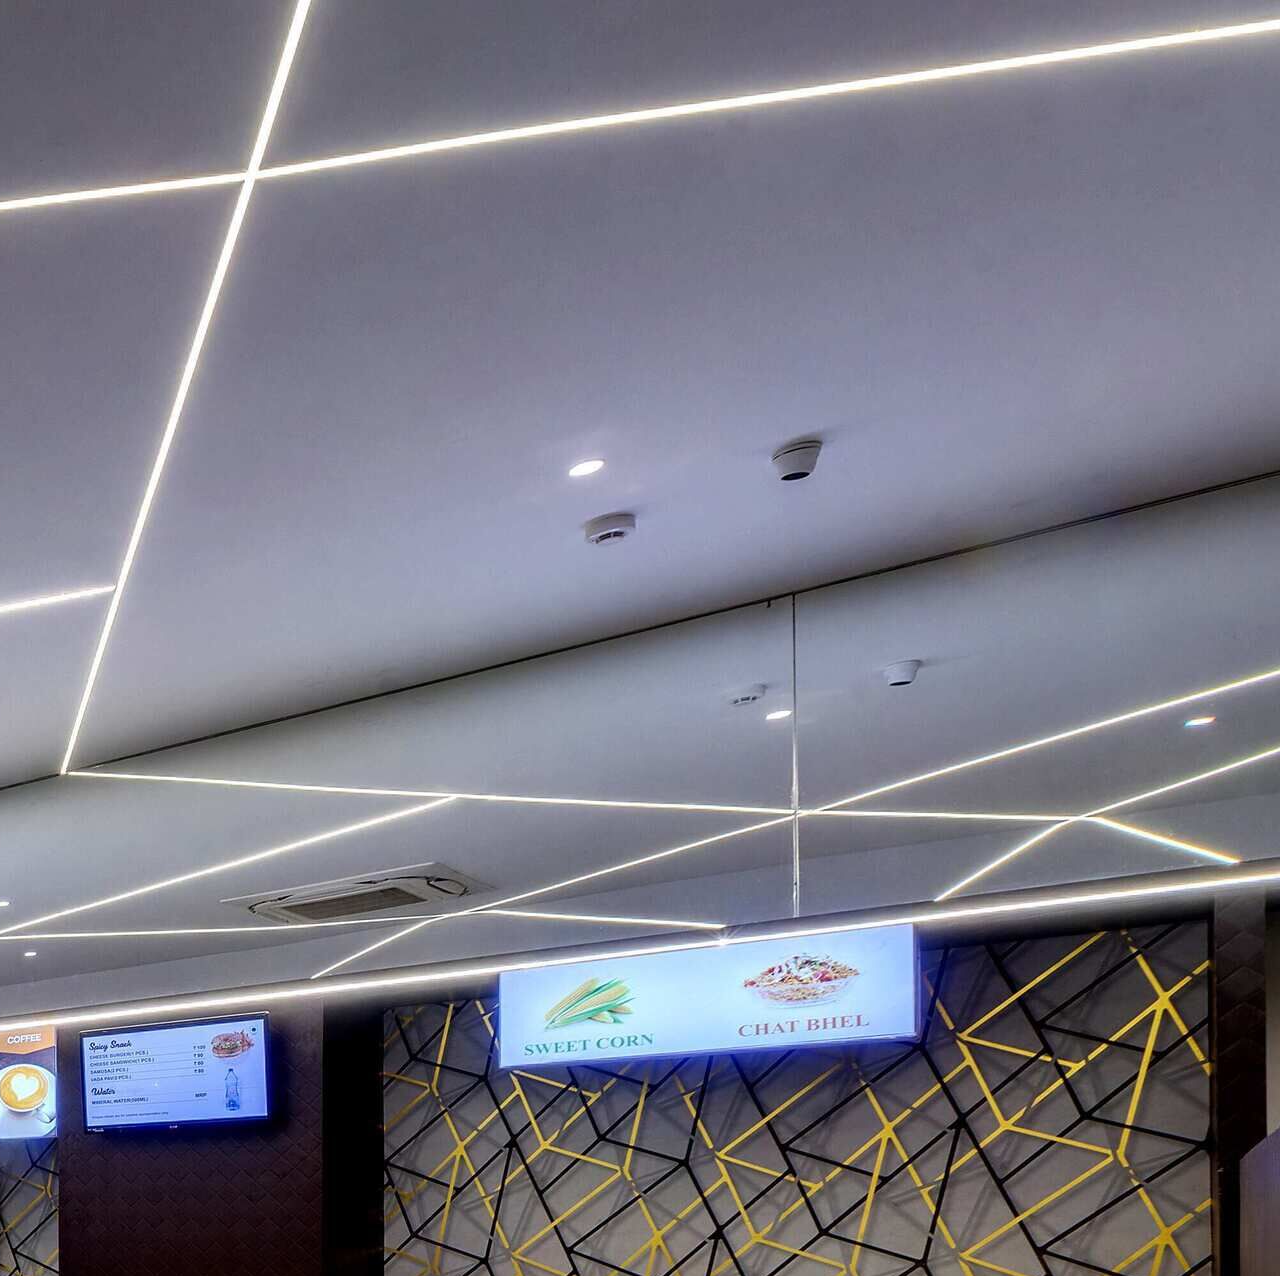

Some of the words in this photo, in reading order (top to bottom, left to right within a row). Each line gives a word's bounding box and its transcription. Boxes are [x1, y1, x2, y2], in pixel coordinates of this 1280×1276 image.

[737, 1020, 800, 1038] CHAT
[807, 1013, 871, 1031] BHEL
[7, 1033, 41, 1044] COFFEE
[89, 1042, 108, 1053] Spicy
[110, 1039, 132, 1049] Snack
[523, 1038, 592, 1056] SWEET
[596, 1032, 655, 1050] CORN
